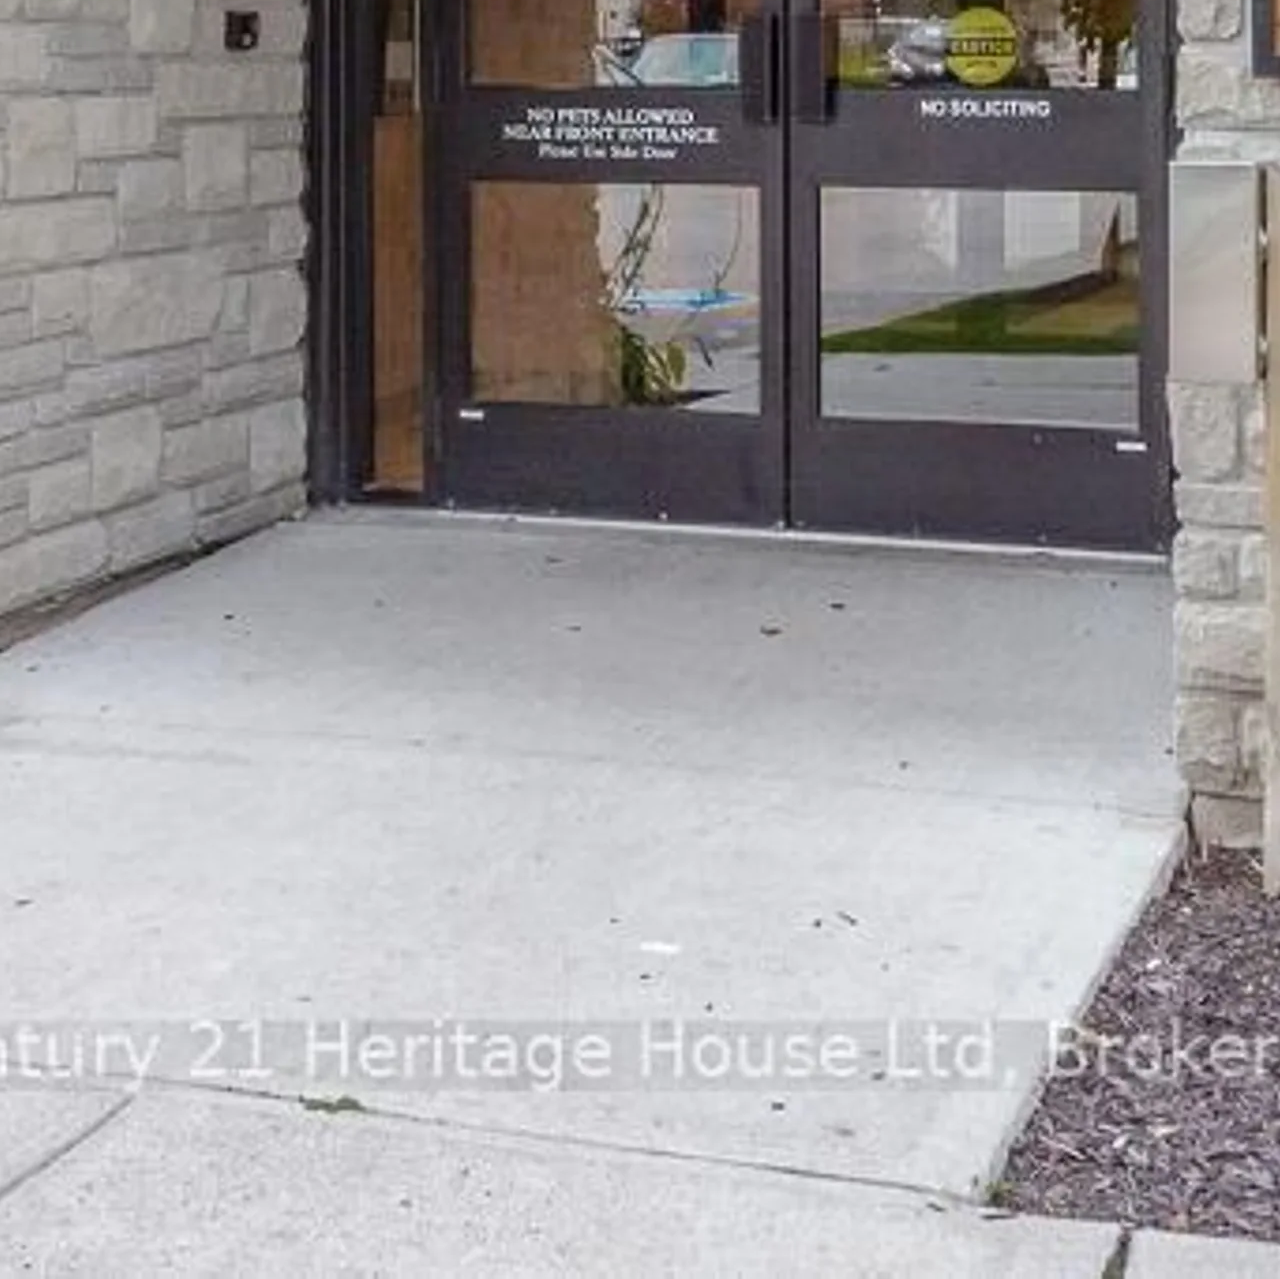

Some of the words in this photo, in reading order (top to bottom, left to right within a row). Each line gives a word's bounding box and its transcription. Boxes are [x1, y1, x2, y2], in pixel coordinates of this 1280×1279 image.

[526, 107, 555, 123] NO
[557, 107, 601, 124] PETS
[602, 107, 695, 125] ALLOWED
[921, 99, 947, 118] NO
[949, 99, 1052, 119] SOLICITING
[503, 124, 552, 140] NEAR
[554, 126, 615, 142] FRONT
[620, 126, 720, 144] ENTRANCE
[642, 145, 679, 159] Door
